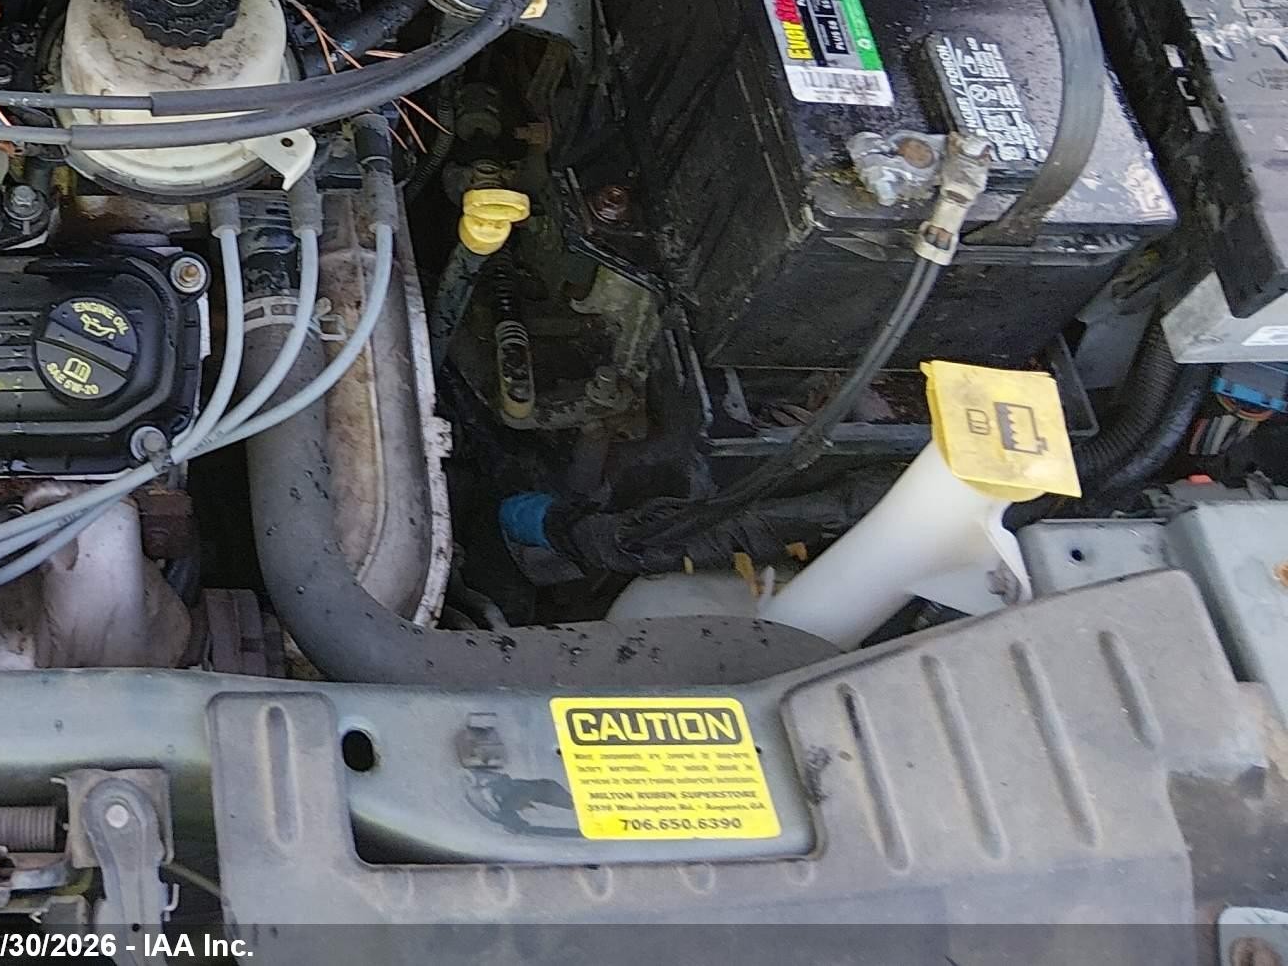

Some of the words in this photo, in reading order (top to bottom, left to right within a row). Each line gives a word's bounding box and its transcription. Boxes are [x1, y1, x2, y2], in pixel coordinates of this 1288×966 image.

[112, 316, 129, 336] OIL
[46, 362, 68, 385] SAE
[571, 712, 737, 742] CAUTION
[680, 790, 757, 800] SUPERSTORE
[619, 817, 743, 832] 706.650.6390
